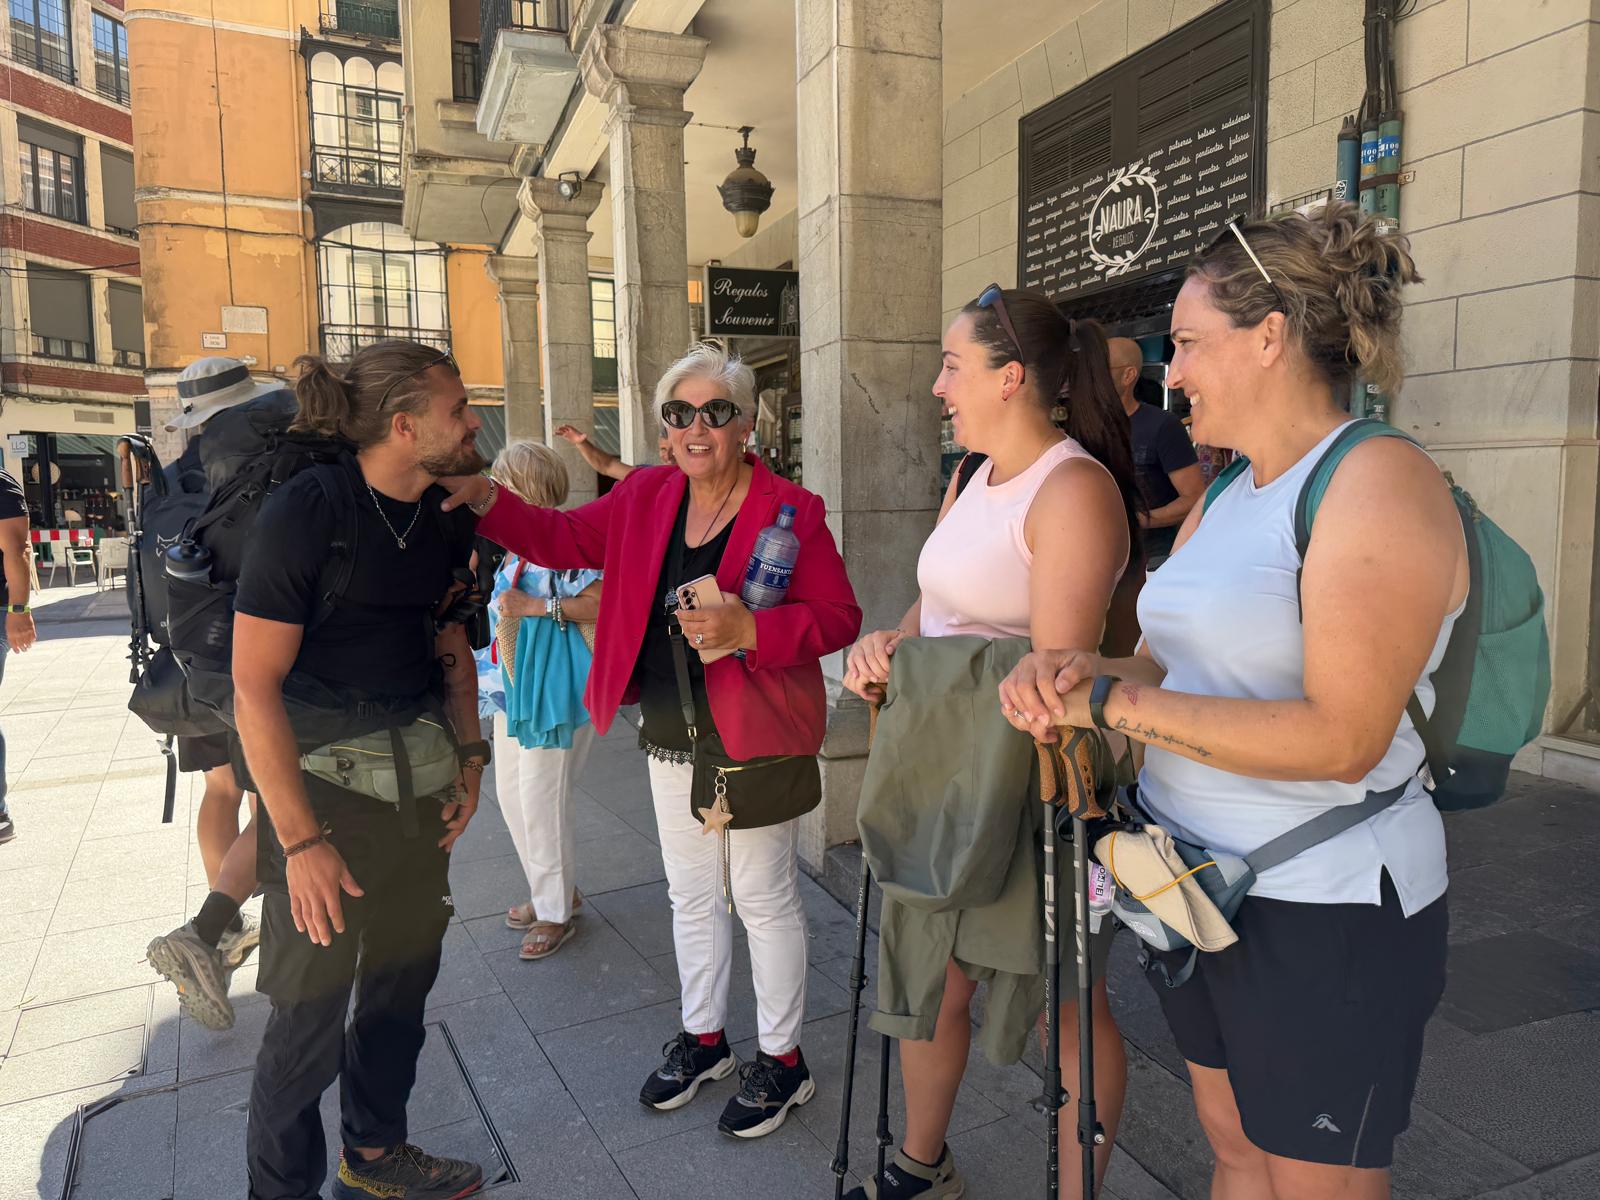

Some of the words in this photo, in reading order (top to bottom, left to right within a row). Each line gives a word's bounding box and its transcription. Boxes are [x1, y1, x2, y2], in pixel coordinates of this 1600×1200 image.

[1101, 194, 1142, 234] NAURA
[1113, 231, 1134, 248] REGALOS
[713, 278, 768, 303] Regalos
[715, 307, 775, 326] Souvenir
